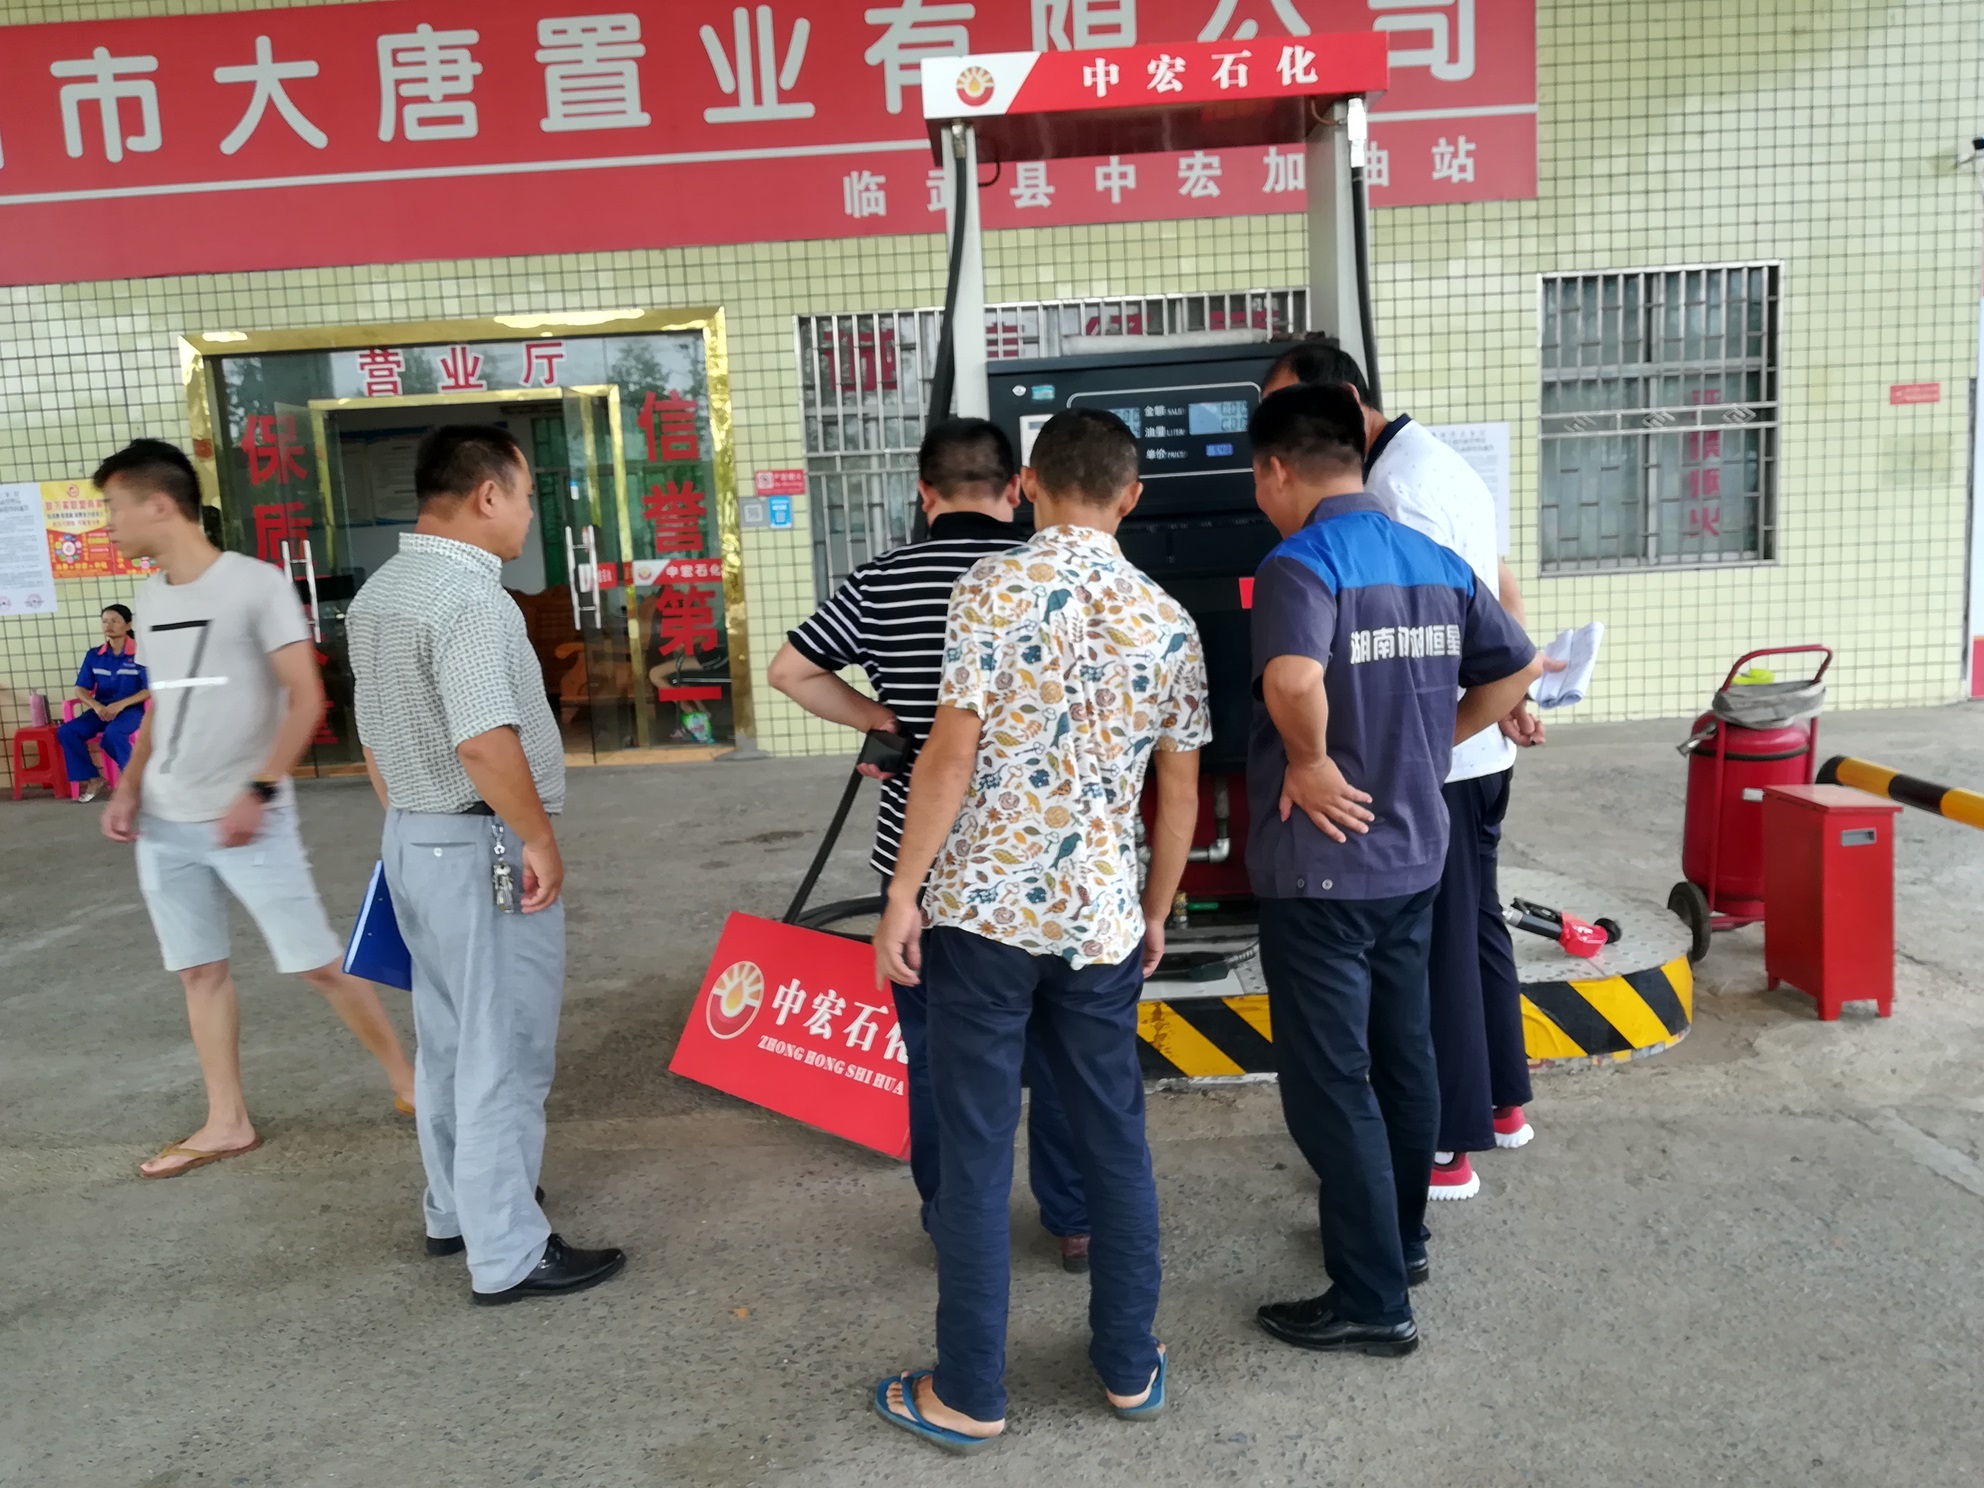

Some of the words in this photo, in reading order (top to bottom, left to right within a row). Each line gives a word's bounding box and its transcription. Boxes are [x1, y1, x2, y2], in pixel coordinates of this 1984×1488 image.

[1082, 45, 1319, 98] 中宏石化
[358, 341, 566, 397] 营业厅
[636, 388, 723, 700] 信誉第一
[757, 1034, 806, 1061] ZHONG
[803, 1049, 846, 1075] HONG
[845, 1063, 874, 1085] SHI
[872, 1072, 905, 1096] HUA
